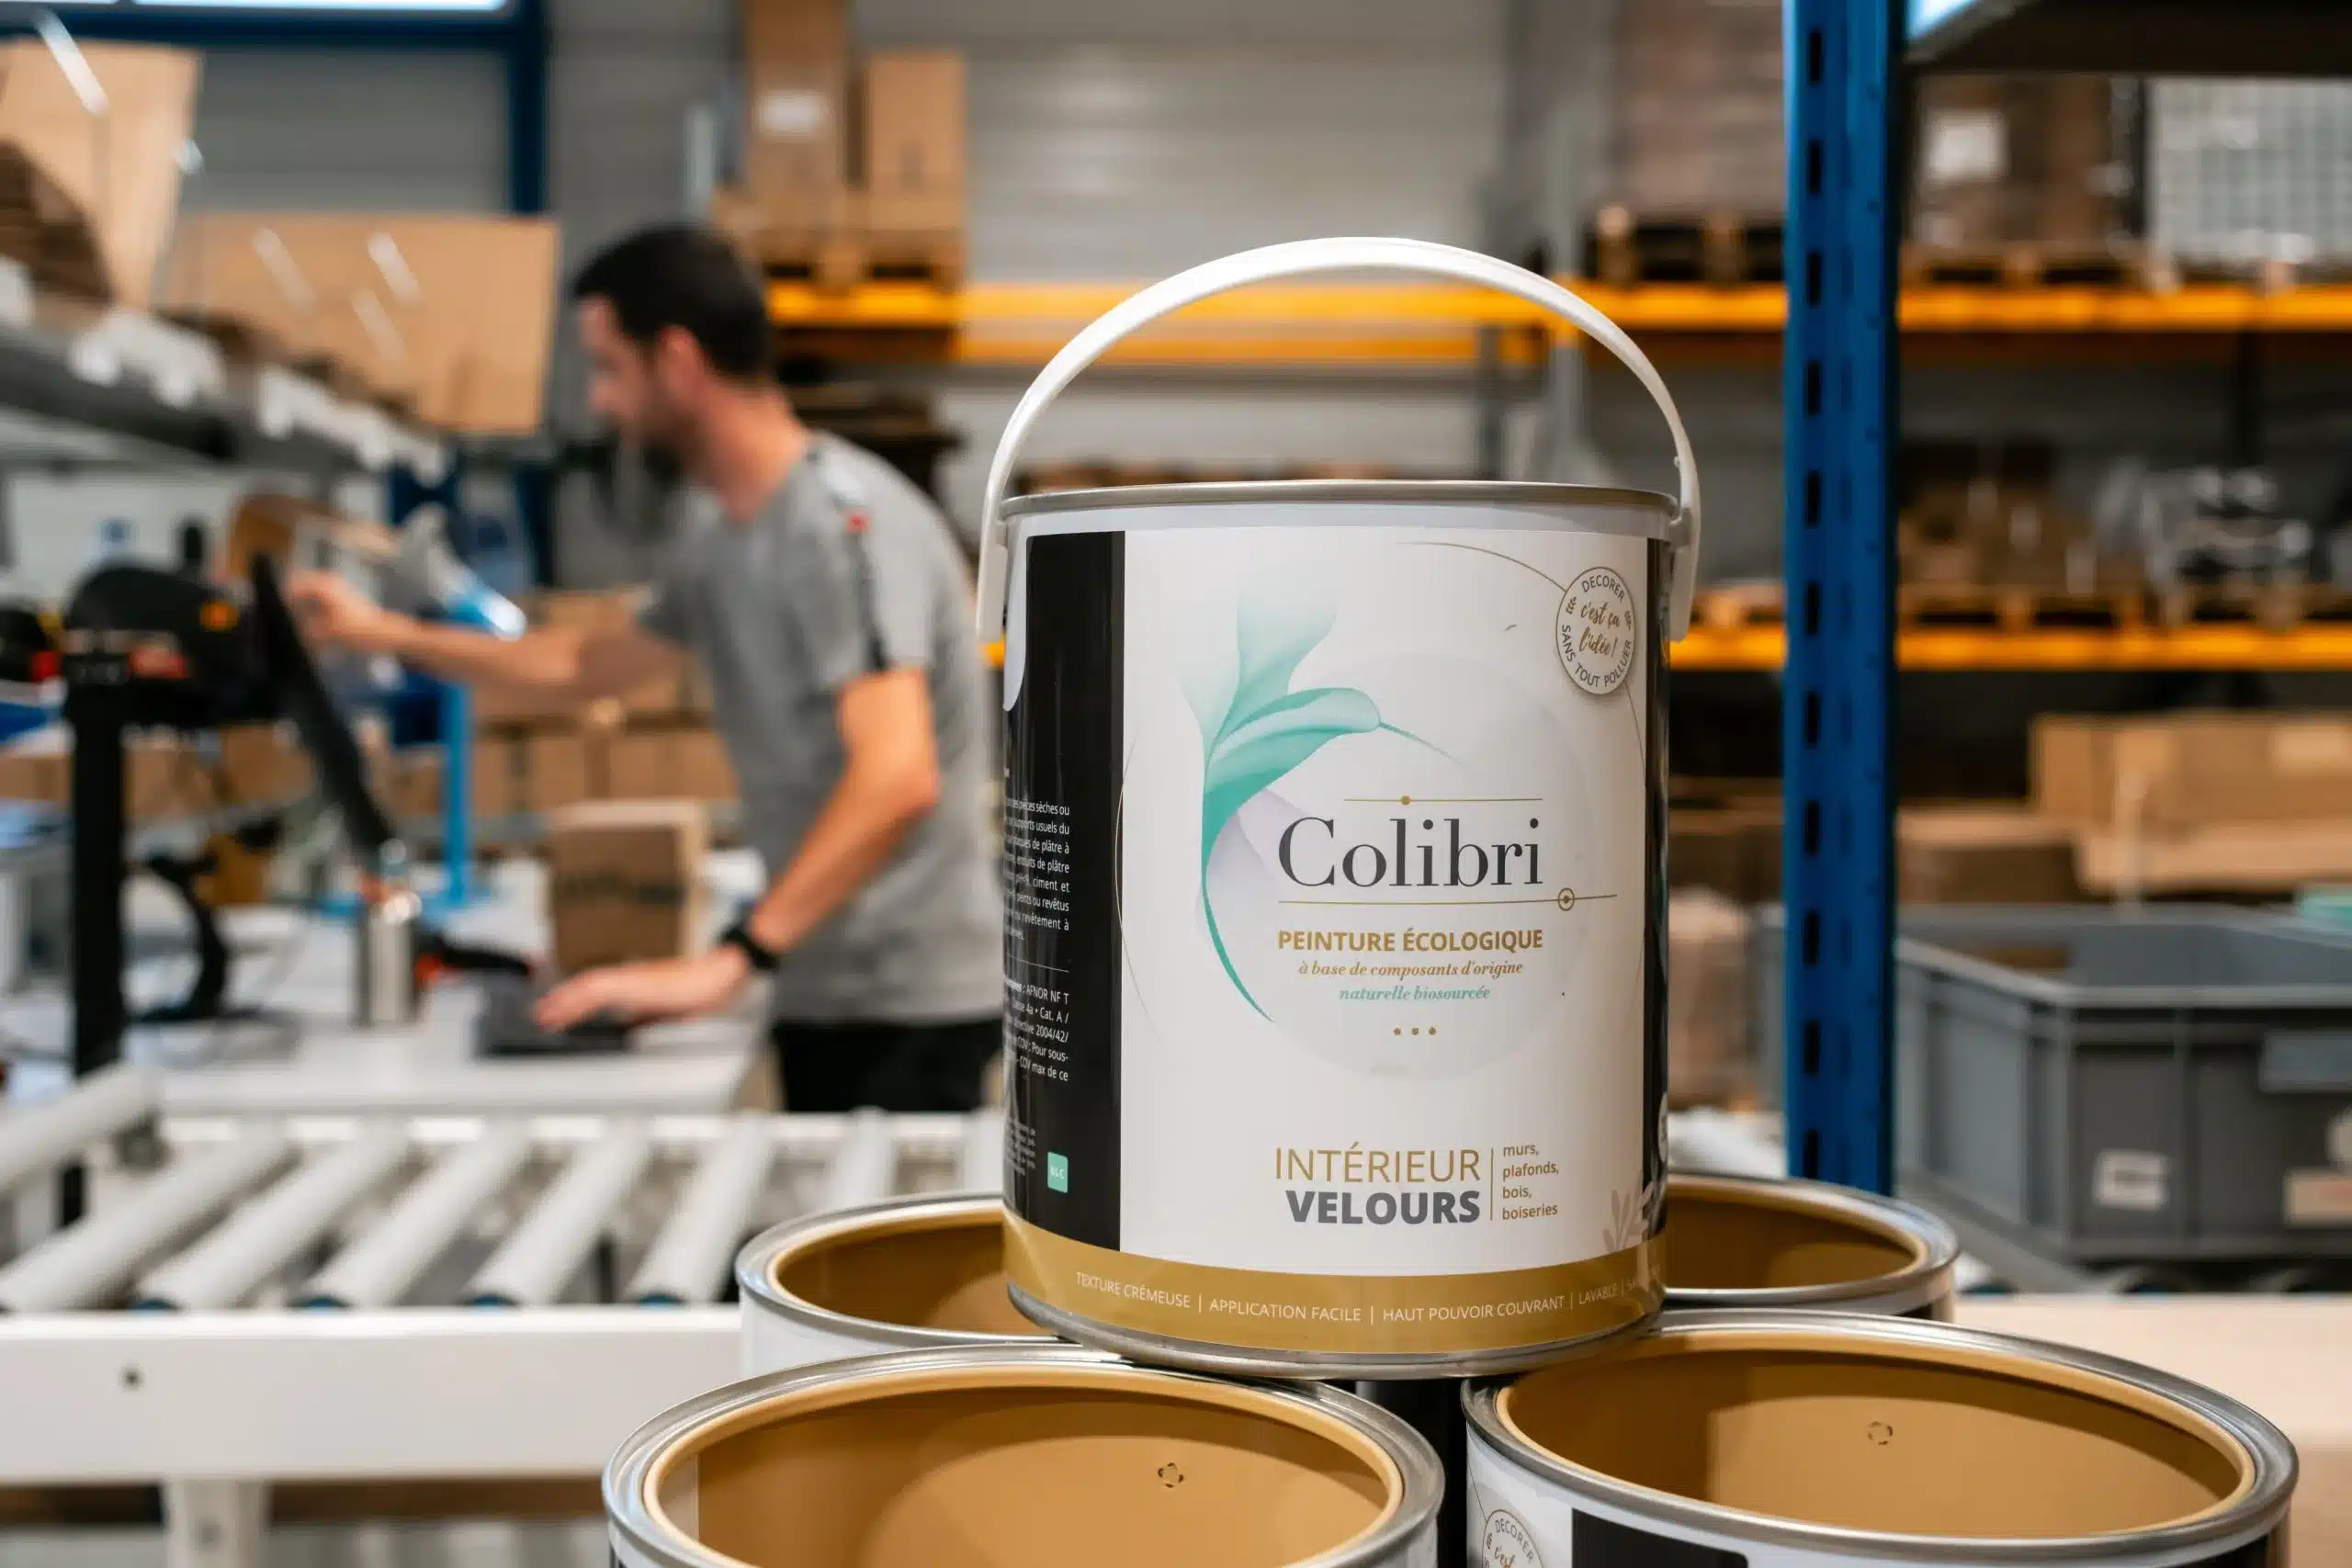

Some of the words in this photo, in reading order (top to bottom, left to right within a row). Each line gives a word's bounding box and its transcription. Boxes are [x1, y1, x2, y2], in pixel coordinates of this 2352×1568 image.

[1581, 575, 1624, 603] DECORER
[1580, 602, 1608, 625] c'est
[1562, 624, 1576, 661] SANS
[1574, 663, 1600, 687] TOUT
[1604, 639, 1633, 687] POLLUER
[1035, 801, 1058, 815] sèches
[1059, 806, 1070, 816] ou
[1035, 820, 1057, 834] usuels
[1058, 822, 1069, 835] du
[1032, 838, 1040, 850] de
[1041, 839, 1062, 853] plâtre
[1064, 842, 1069, 854] à
[1279, 817, 1544, 887] Colibri
[1037, 858, 1046, 870] de
[1047, 860, 1069, 874] plâtre
[1033, 876, 1057, 891] ciment
[1061, 882, 1069, 893] et
[1033, 897, 1041, 907] ou
[1042, 898, 1069, 912] revêtus
[1022, 912, 1061, 930] revêtement
[1064, 919, 1069, 931] à
[1278, 930, 1396, 952] PEINTURE
[1403, 927, 1544, 953] ÉCOLOGIQUE
[1298, 961, 1308, 976] à
[1311, 962, 1346, 976] base
[1350, 962, 1367, 976] de
[1370, 962, 1458, 981] composants
[1461, 961, 1524, 979] d'origine
[1026, 985, 1048, 1000] AFNOR
[1050, 990, 1061, 1003] NF
[1064, 993, 1069, 1005] T
[1339, 985, 1411, 1000] naturelle
[1414, 985, 1490, 1000] biosourcée
[1040, 1007, 1054, 1021] Cat.
[1056, 1011, 1063, 1022] A
[1035, 1024, 1069, 1043] 2004/42/
[1032, 1042, 1046, 1056] Pour
[1047, 1049, 1069, 1062] sous-
[1032, 1063, 1046, 1075] max
[1047, 1066, 1057, 1078] de
[1058, 1071, 1069, 1081] ce
[1503, 1143, 1539, 1157] murs,
[1275, 1142, 1481, 1183] INTÉRIEUR
[1503, 1160, 1559, 1180] plafonds,
[1503, 1184, 1532, 1200] bois,
[1285, 1190, 1481, 1224] VELOURS
[1502, 1203, 1558, 1221] boiseries
[1076, 1271, 1121, 1297] TEXTURE
[1209, 1298, 1306, 1320] APPLICATION
[1312, 1306, 1362, 1322] FACILE
[1383, 1307, 1425, 1322] HAUT
[1429, 1304, 1494, 1322] POUVOIR
[1497, 1296, 1565, 1317] COUVRANT
[1495, 1518, 1533, 1563] DECORER
